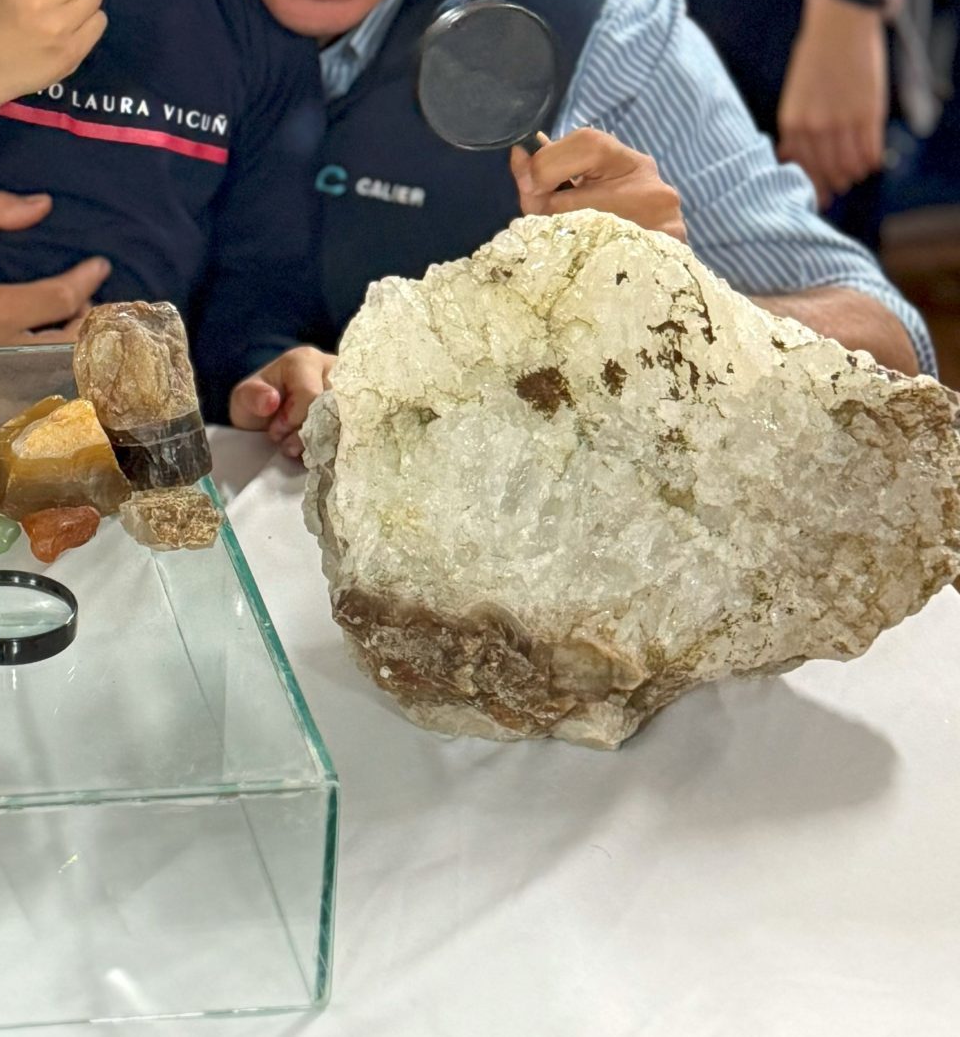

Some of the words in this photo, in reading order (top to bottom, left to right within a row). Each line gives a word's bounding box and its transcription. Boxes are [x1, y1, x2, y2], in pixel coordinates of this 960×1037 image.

[72, 90, 149, 117] LAURA
[163, 103, 228, 136] VICUÑ
[355, 177, 425, 207] CALIER
